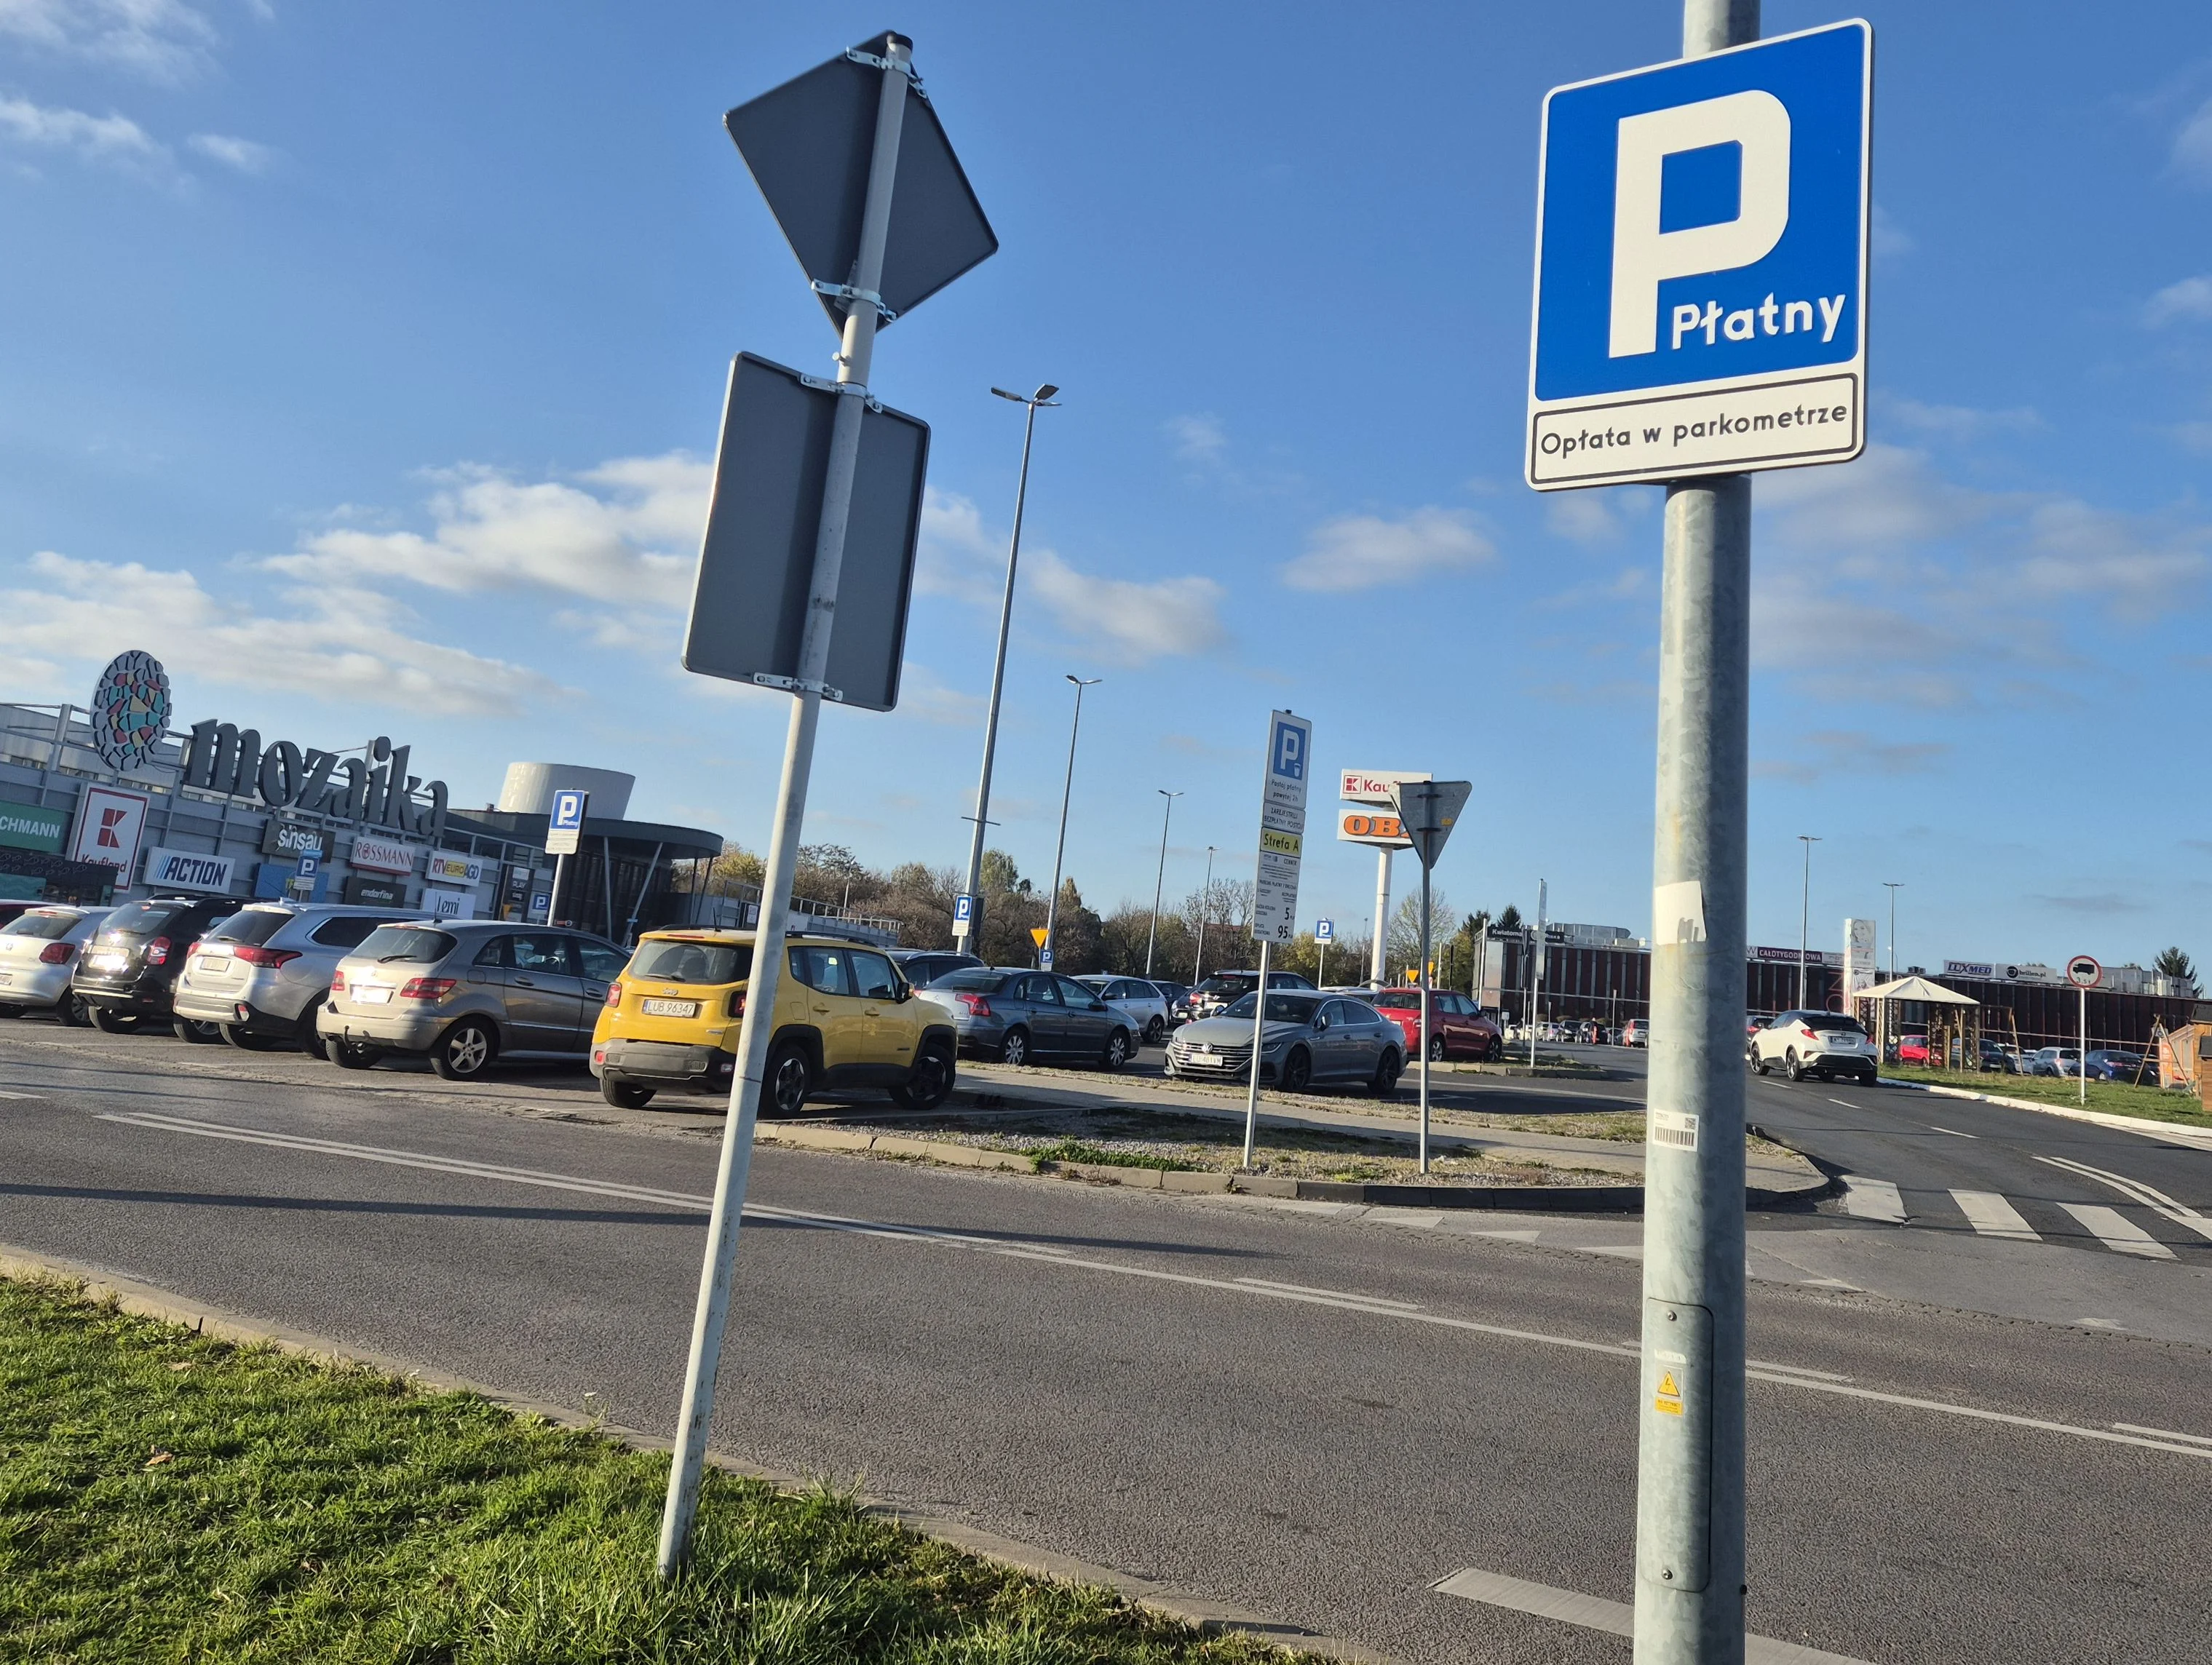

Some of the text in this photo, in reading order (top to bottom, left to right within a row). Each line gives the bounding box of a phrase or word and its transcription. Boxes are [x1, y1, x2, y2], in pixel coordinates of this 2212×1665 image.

[1608, 90, 1792, 359] P
[1672, 292, 1847, 349] Płatny
[1540, 403, 1848, 458] Opłata w parkometrze
[1280, 729, 1300, 770] P
[183, 718, 448, 838] mozaika
[1364, 779, 1401, 793] Kau
[557, 795, 577, 825] P
[0, 816, 60, 838] CHMANN
[1264, 833, 1299, 852] Strefa A
[355, 841, 413, 867] ROSSMANN
[163, 857, 227, 886] ACTION
[301, 859, 314, 875] P
[446, 863, 464, 874] EURO
[360, 889, 393, 900] endorfina
[536, 897, 546, 909] P
[958, 899, 968, 918] P
[1284, 907, 1290, 921] 5
[1277, 925, 1288, 939] 95
[1320, 922, 1329, 937] P
[1491, 929, 1523, 938] Kwiatoma
[1759, 949, 1821, 961] CAŁOTYGODNOWA
[648, 1001, 694, 1014] LUB 96347
